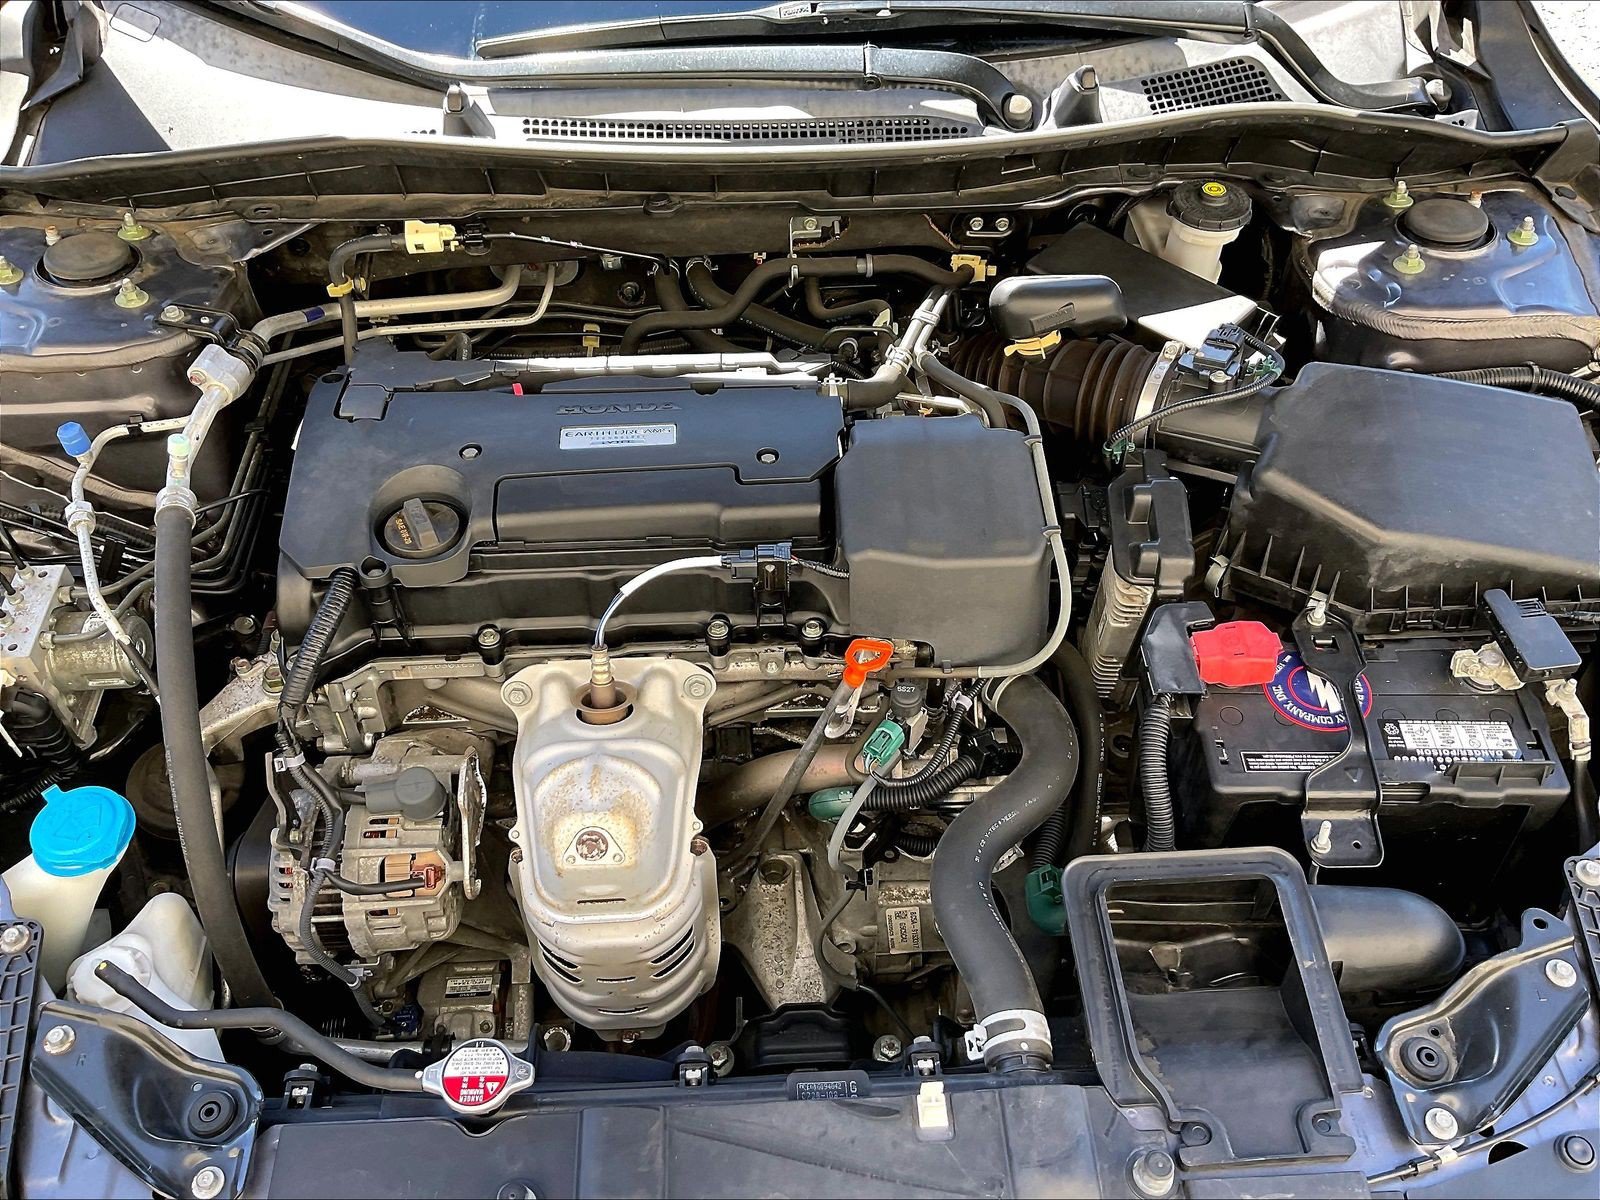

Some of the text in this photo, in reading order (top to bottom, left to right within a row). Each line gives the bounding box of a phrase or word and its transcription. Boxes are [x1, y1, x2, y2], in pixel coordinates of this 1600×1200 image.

[557, 402, 681, 415] HONDA
[1416, 748, 1504, 758] DANGER/POISON
[849, 1080, 858, 1093] G
[459, 1095, 484, 1103] DANGER
